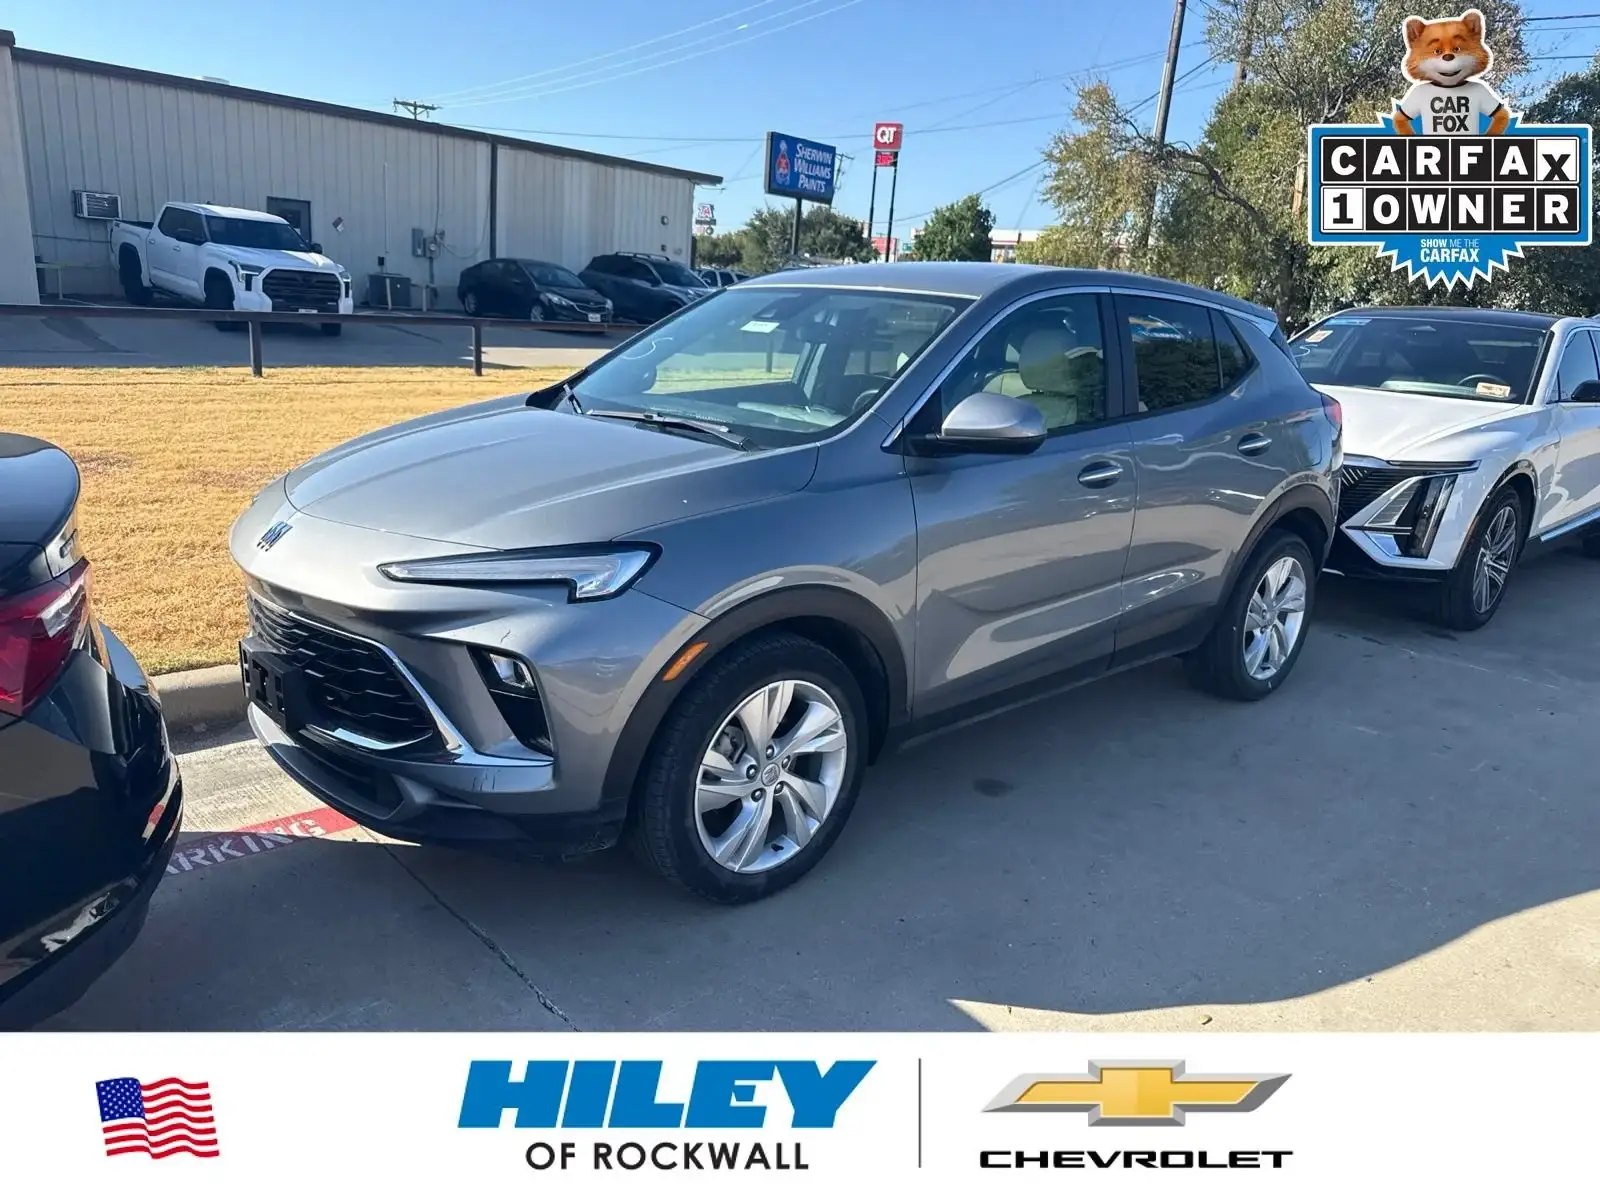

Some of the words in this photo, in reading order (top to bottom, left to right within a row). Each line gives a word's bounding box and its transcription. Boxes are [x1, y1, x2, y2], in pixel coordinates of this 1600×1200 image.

[876, 126, 897, 144] QT
[794, 157, 832, 179] WILLIAMS
[798, 174, 826, 193] PAINTS
